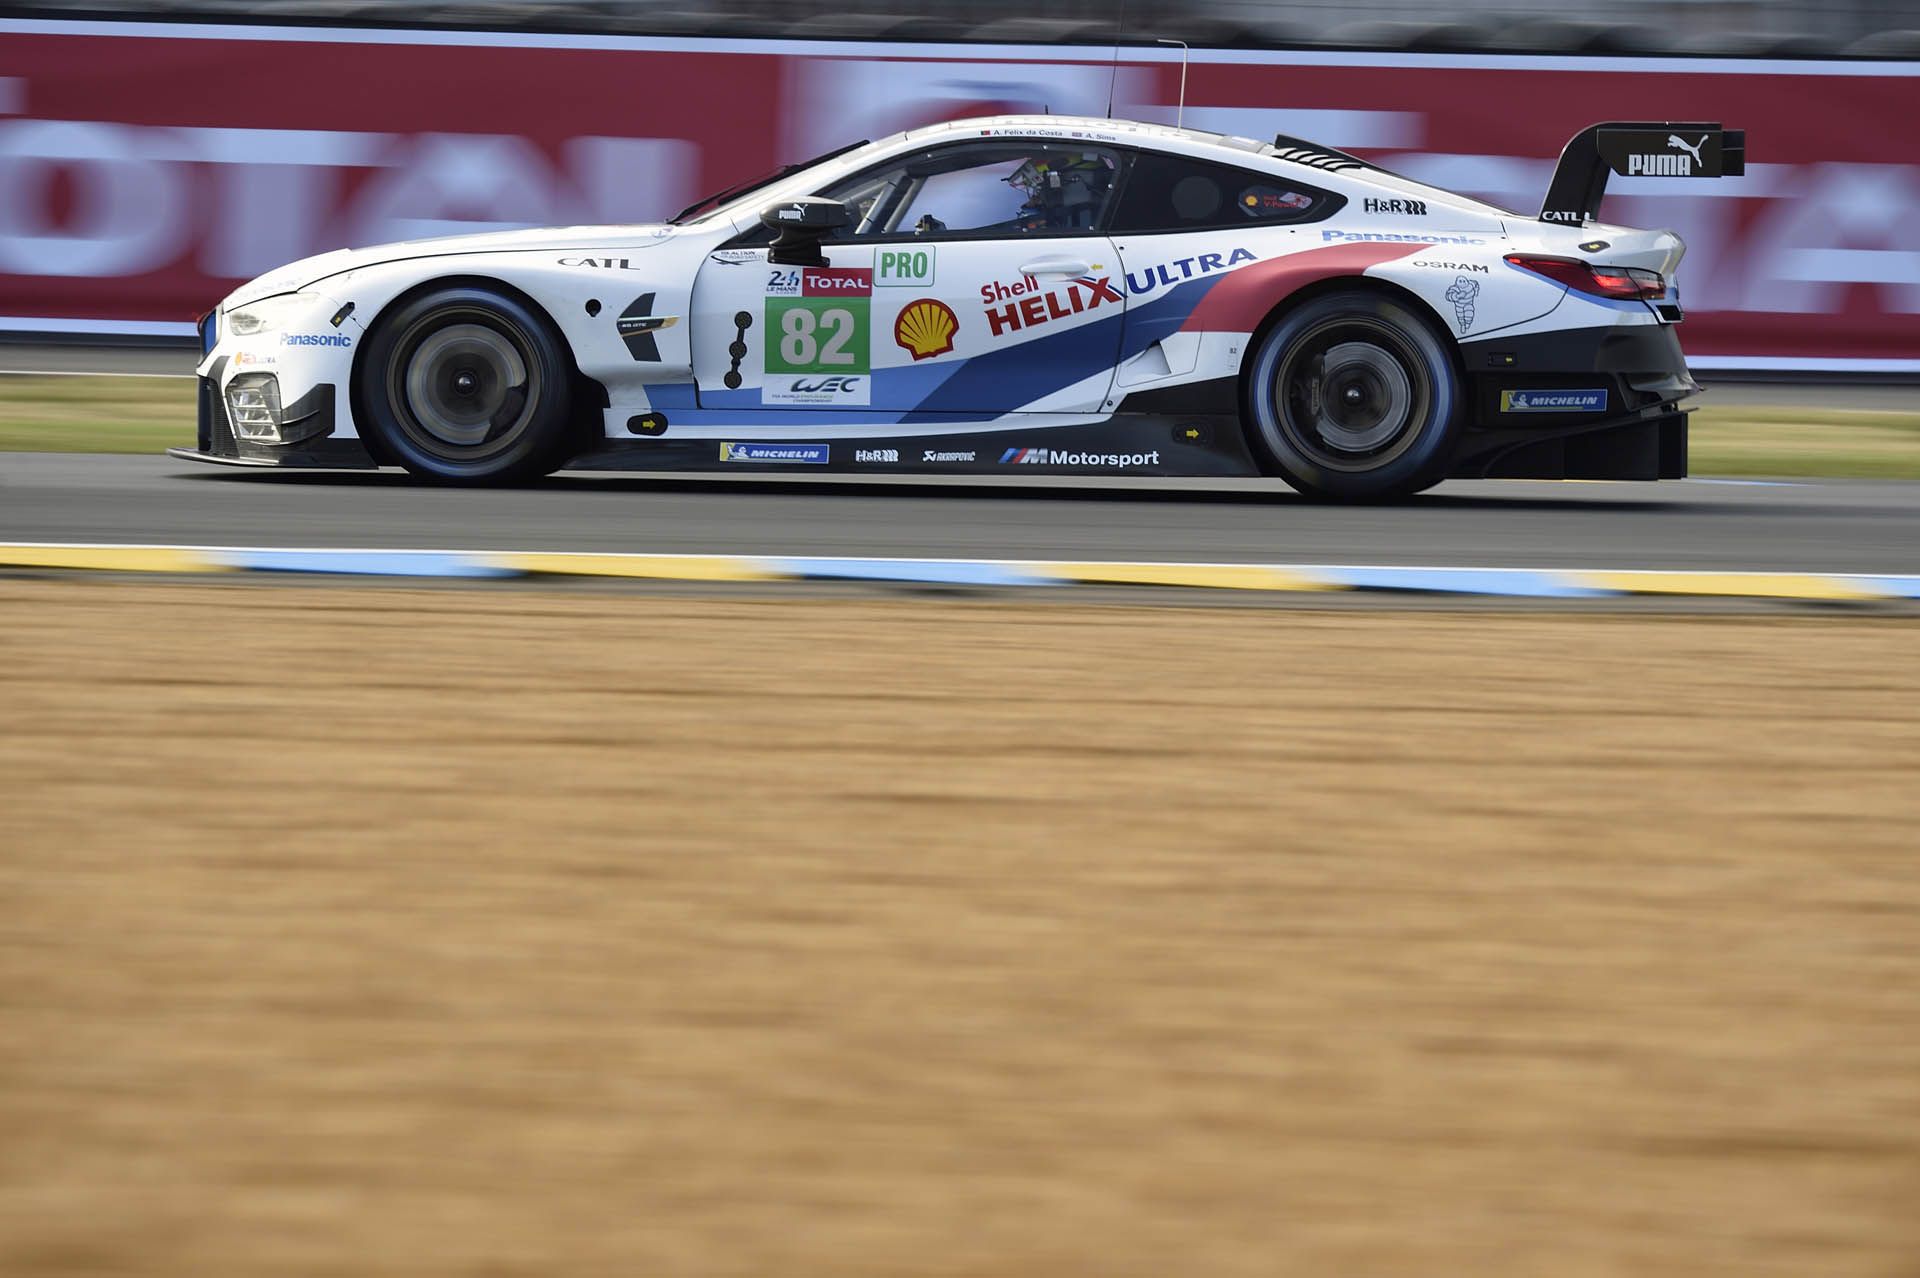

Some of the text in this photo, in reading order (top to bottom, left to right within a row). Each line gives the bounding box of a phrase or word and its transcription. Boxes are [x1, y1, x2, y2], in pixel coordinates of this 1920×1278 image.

[1039, 129, 1063, 137] Costa
[1628, 153, 1691, 176] PUMA
[1364, 198, 1402, 214] H&R
[778, 209, 802, 220] PUMA
[1542, 211, 1582, 221] CATL
[1322, 229, 1488, 246] Panasonic
[557, 257, 641, 271] CATL
[880, 251, 928, 278] PRO
[1125, 247, 1259, 295] ULTRA
[1412, 260, 1490, 274] OSRAM
[805, 275, 870, 289] TOTAL
[981, 274, 1039, 306] Shell
[984, 276, 1126, 337] HELIX
[279, 332, 352, 348] Panasonic
[780, 308, 856, 366] 82
[790, 376, 861, 393] WEC
[1530, 396, 1598, 406] MICHELIN
[750, 448, 820, 460] MICHELIN
[855, 449, 883, 463] H&R
[1050, 450, 1160, 468] Motorsport
